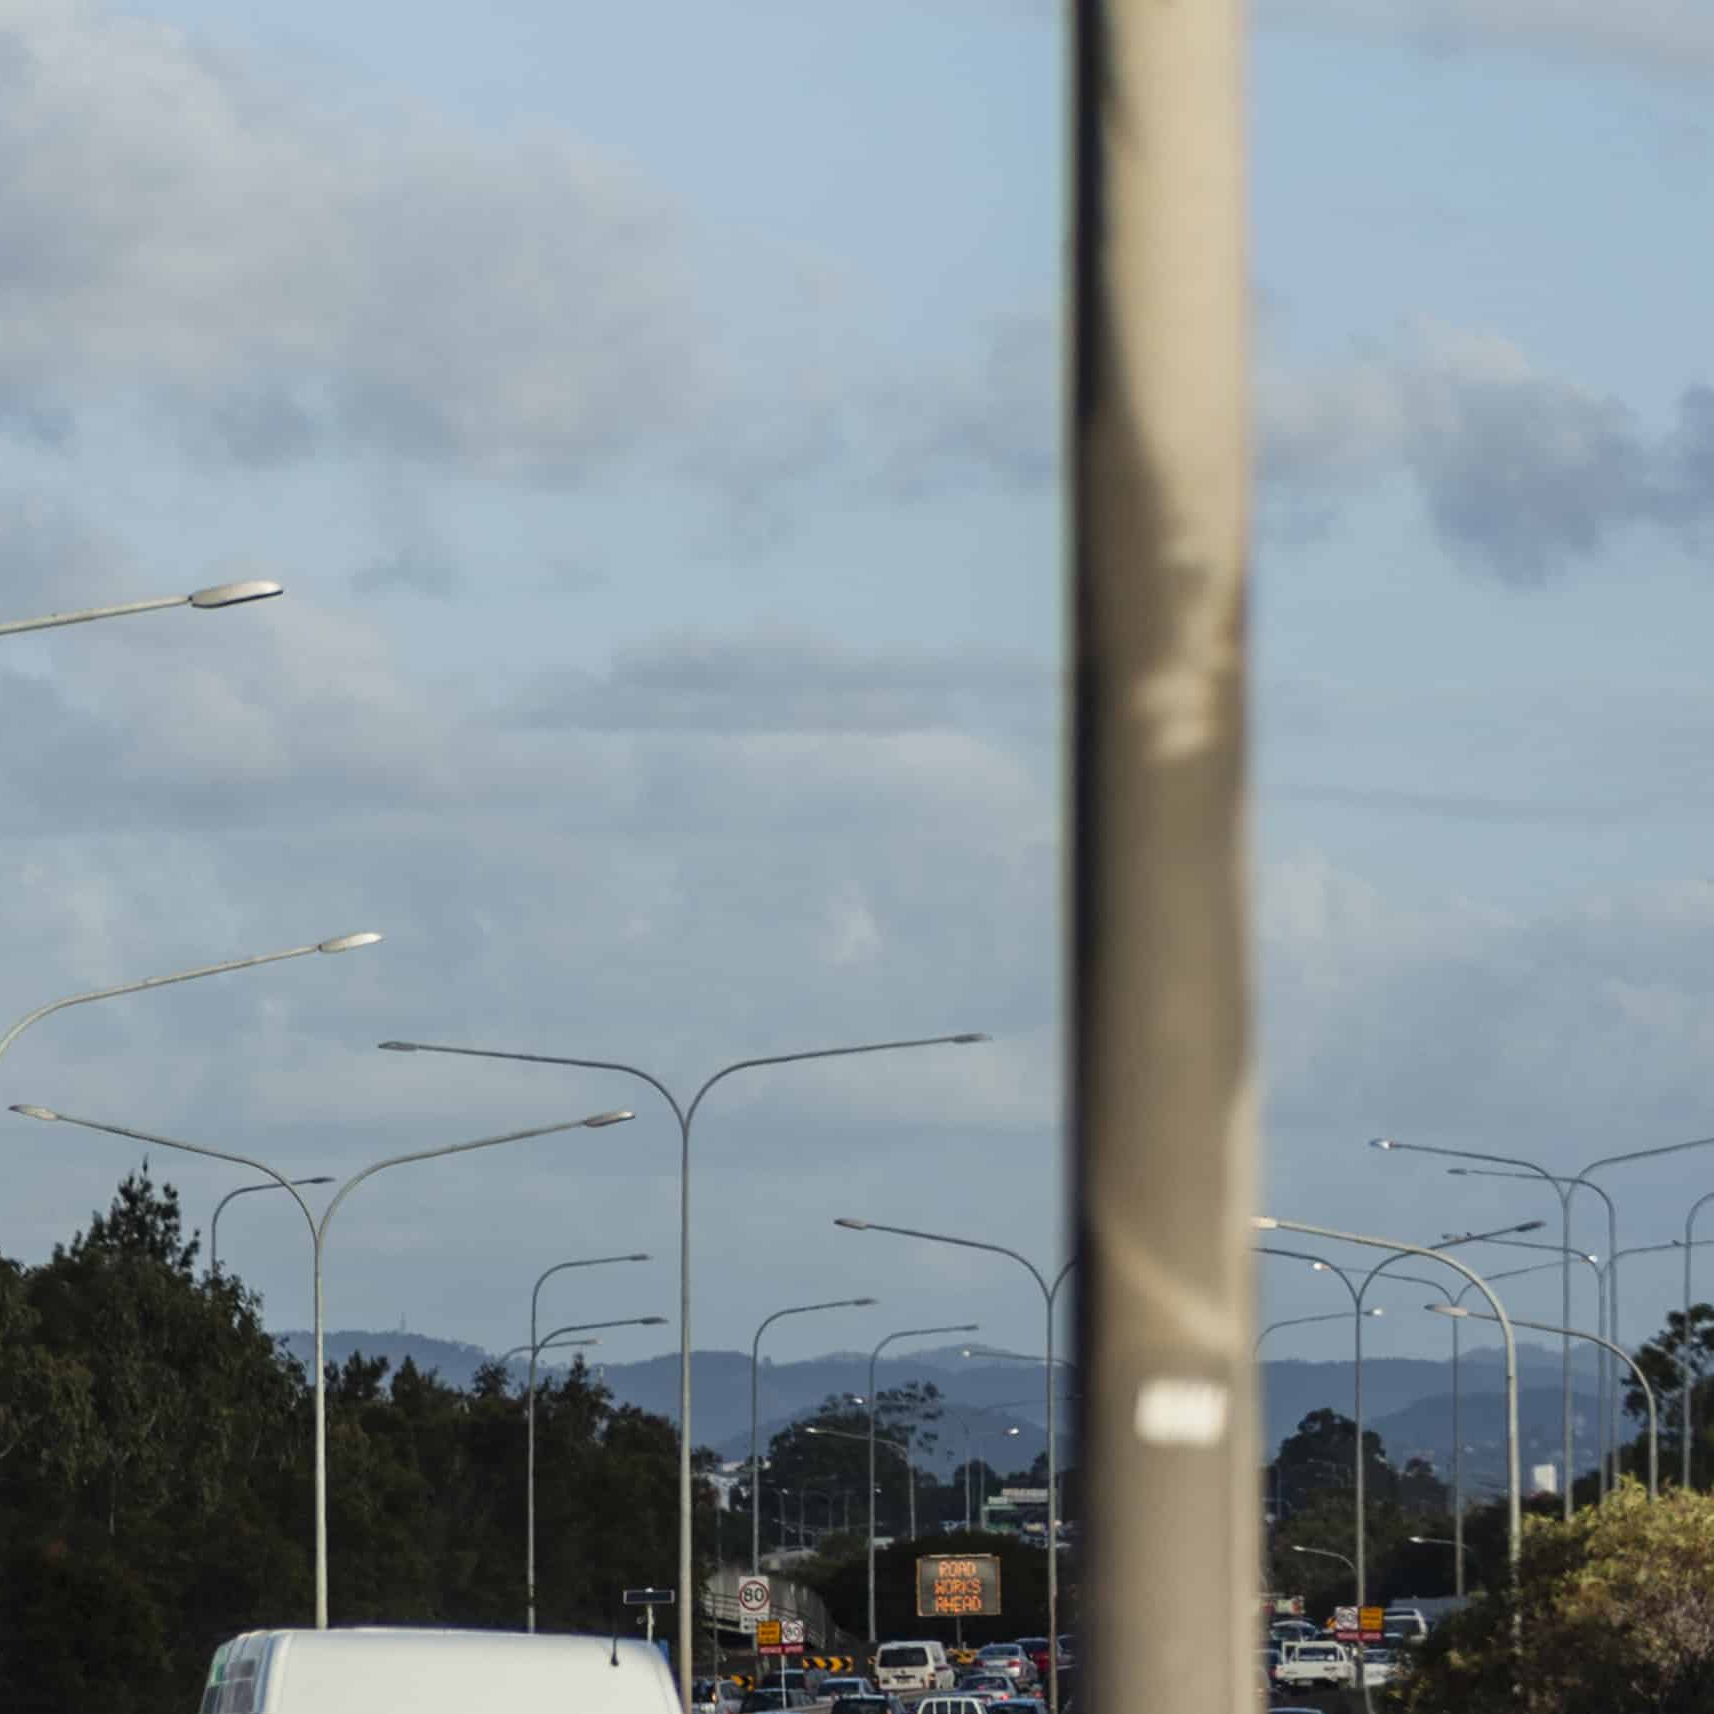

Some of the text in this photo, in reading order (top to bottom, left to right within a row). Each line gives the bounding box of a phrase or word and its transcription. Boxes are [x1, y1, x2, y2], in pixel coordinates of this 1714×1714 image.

[938, 1560, 977, 1577] ROAD
[744, 1587, 764, 1602] 80
[934, 1578, 982, 1595] WORKS
[934, 1595, 982, 1612] AHEAD
